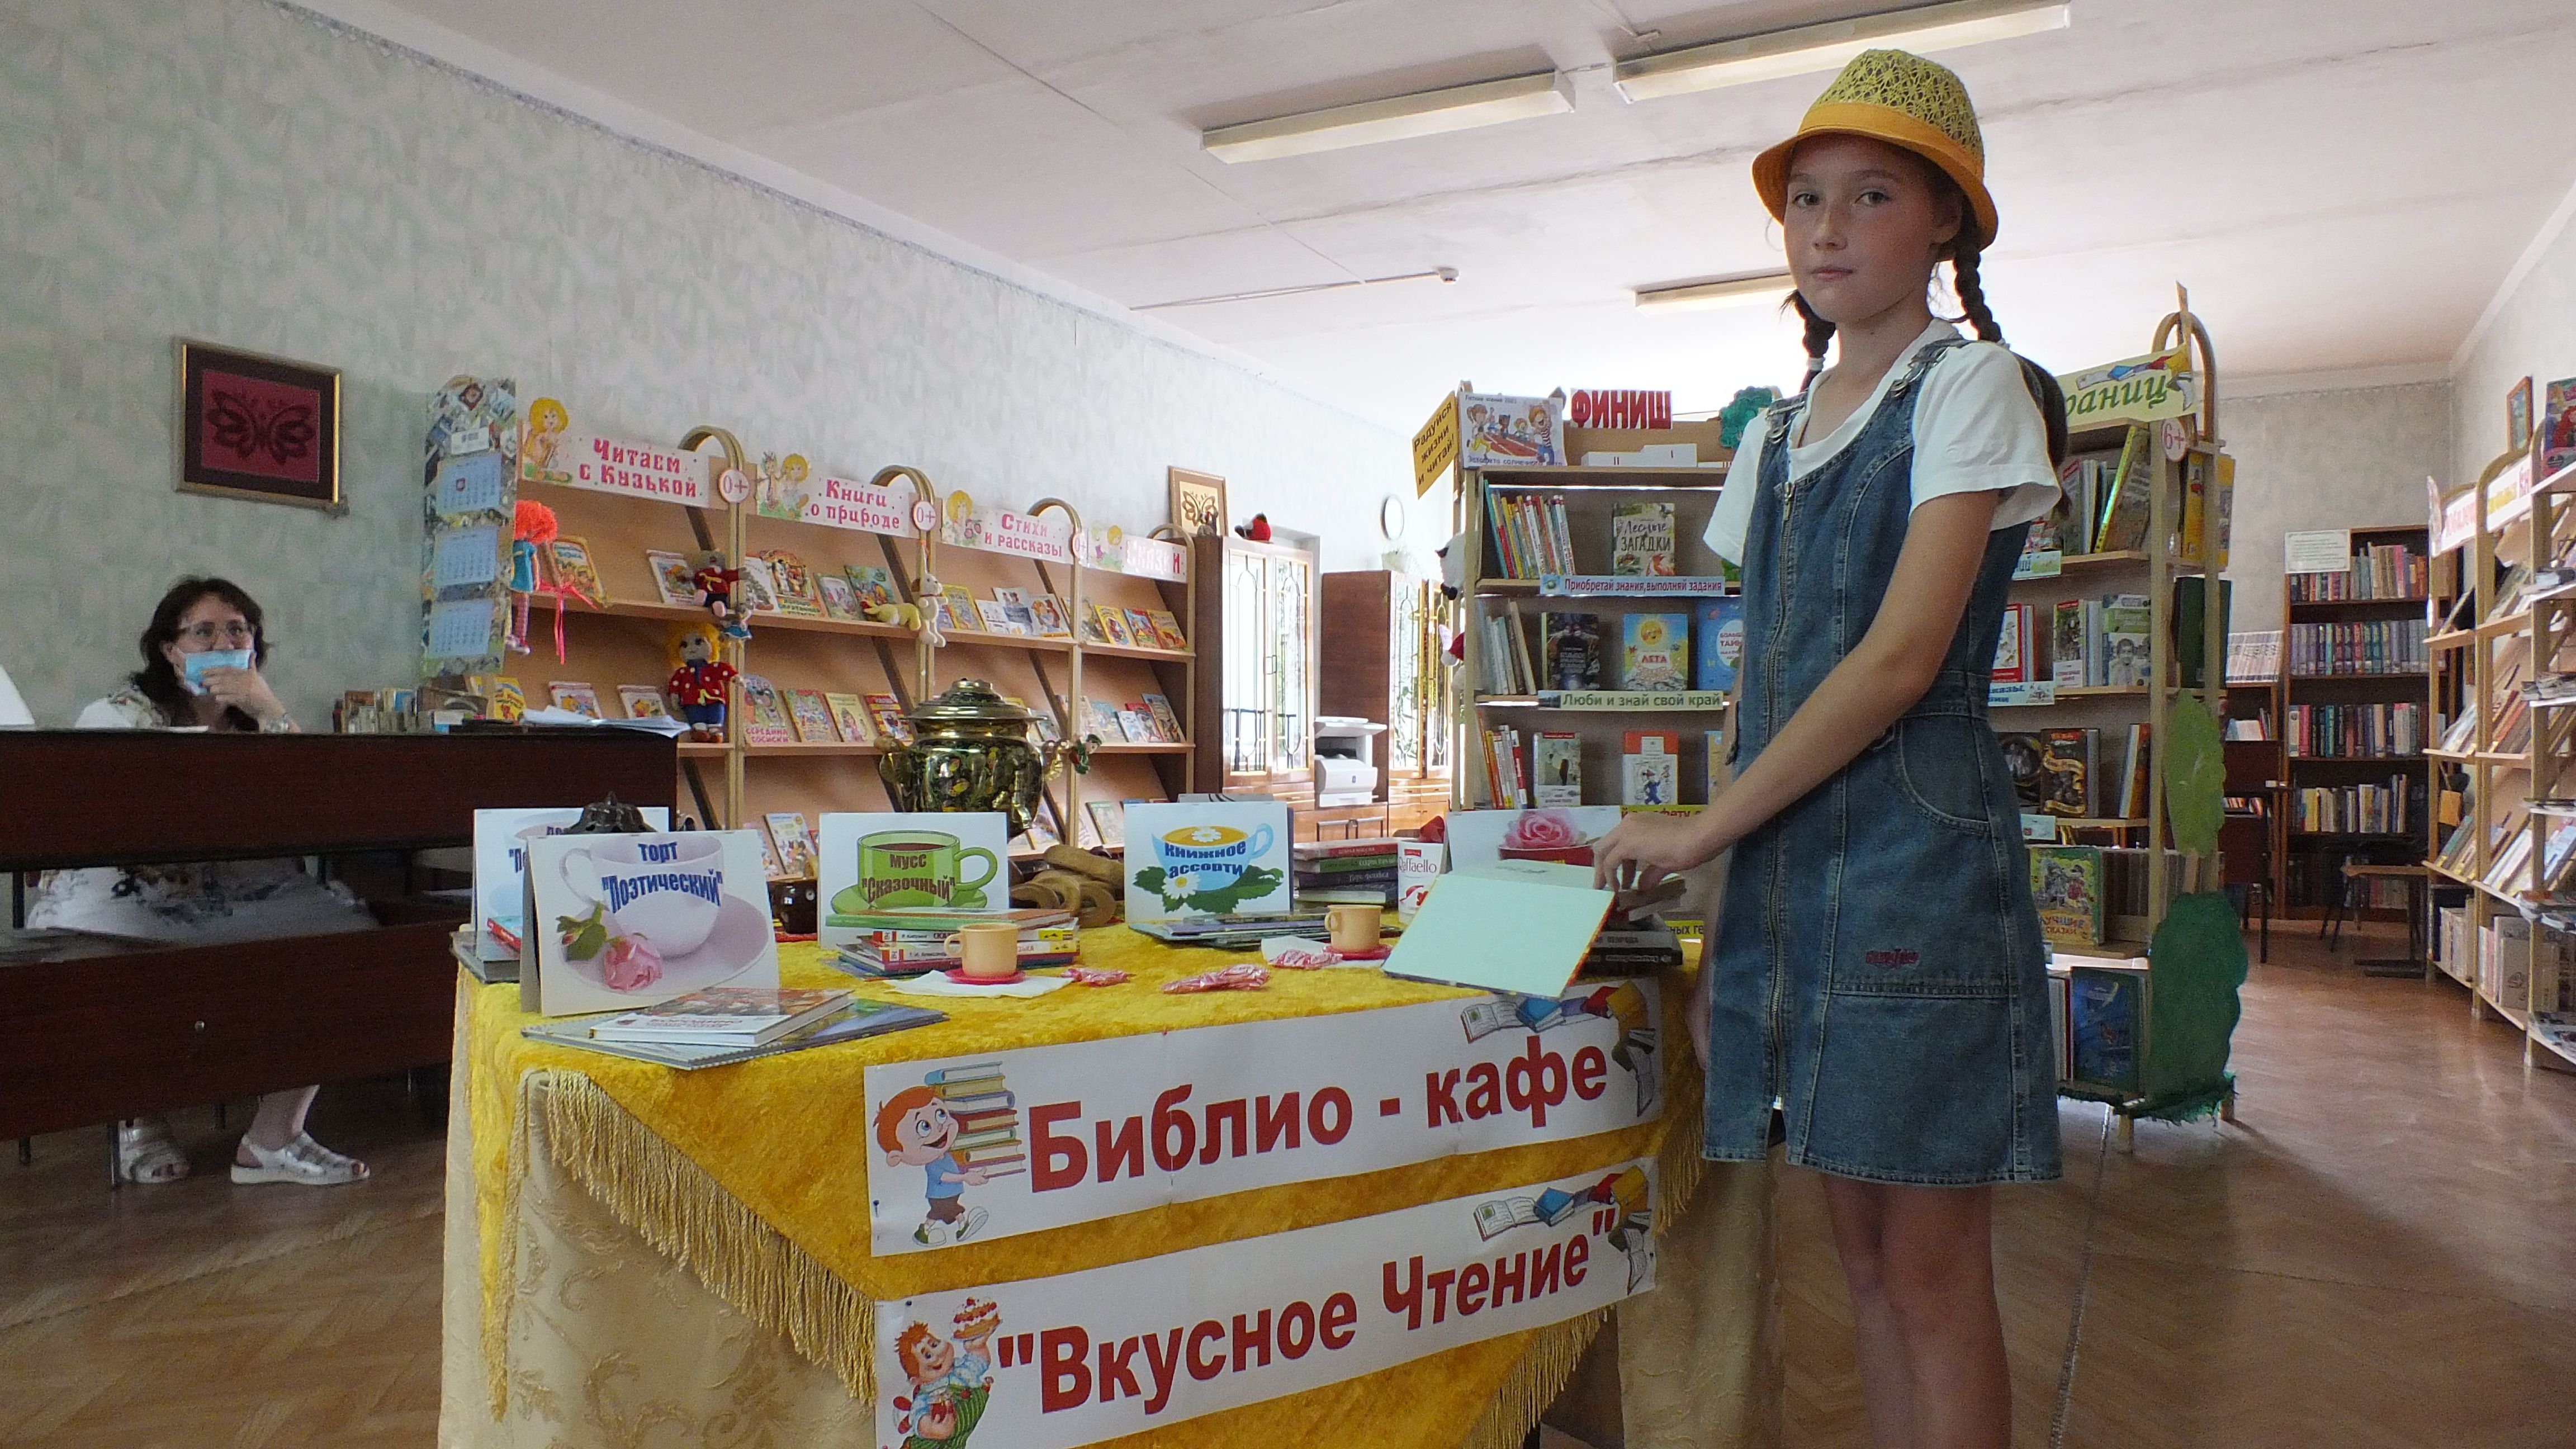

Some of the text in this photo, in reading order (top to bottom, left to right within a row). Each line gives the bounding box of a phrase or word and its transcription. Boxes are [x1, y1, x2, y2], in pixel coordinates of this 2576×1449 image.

[1571, 390, 1671, 429] ФИНИШ
[2066, 375, 2167, 416] раниц
[1414, 401, 1451, 452] Радуйся
[594, 438, 681, 473] Читаем
[1422, 425, 1450, 463] жизни
[1419, 433, 1454, 485] и читай!
[602, 464, 697, 498] Кузькой
[723, 479, 748, 494] 0+
[826, 479, 887, 507] Книги
[827, 505, 899, 529] природе
[916, 507, 936, 523] 0+
[1002, 514, 1048, 537] Стихи
[1623, 520, 1666, 534] Лесные
[985, 532, 1062, 557] и рассказы
[1621, 537, 1670, 552] ЗАГАДКИ
[1565, 579, 1613, 591] Приобретай
[1689, 581, 1722, 591] задания
[1563, 693, 1720, 707] Люби и знай свой край
[1169, 864, 1243, 878] ассорти
[1399, 856, 1437, 873] Raffaello
[602, 869, 723, 913] "Поэтический"
[862, 874, 955, 904] "Сказочный"
[1029, 1085, 1353, 1192] Библио
[1426, 1036, 1607, 1126] кафе
[999, 1209, 1614, 1414] "Вкусное Чтение"
